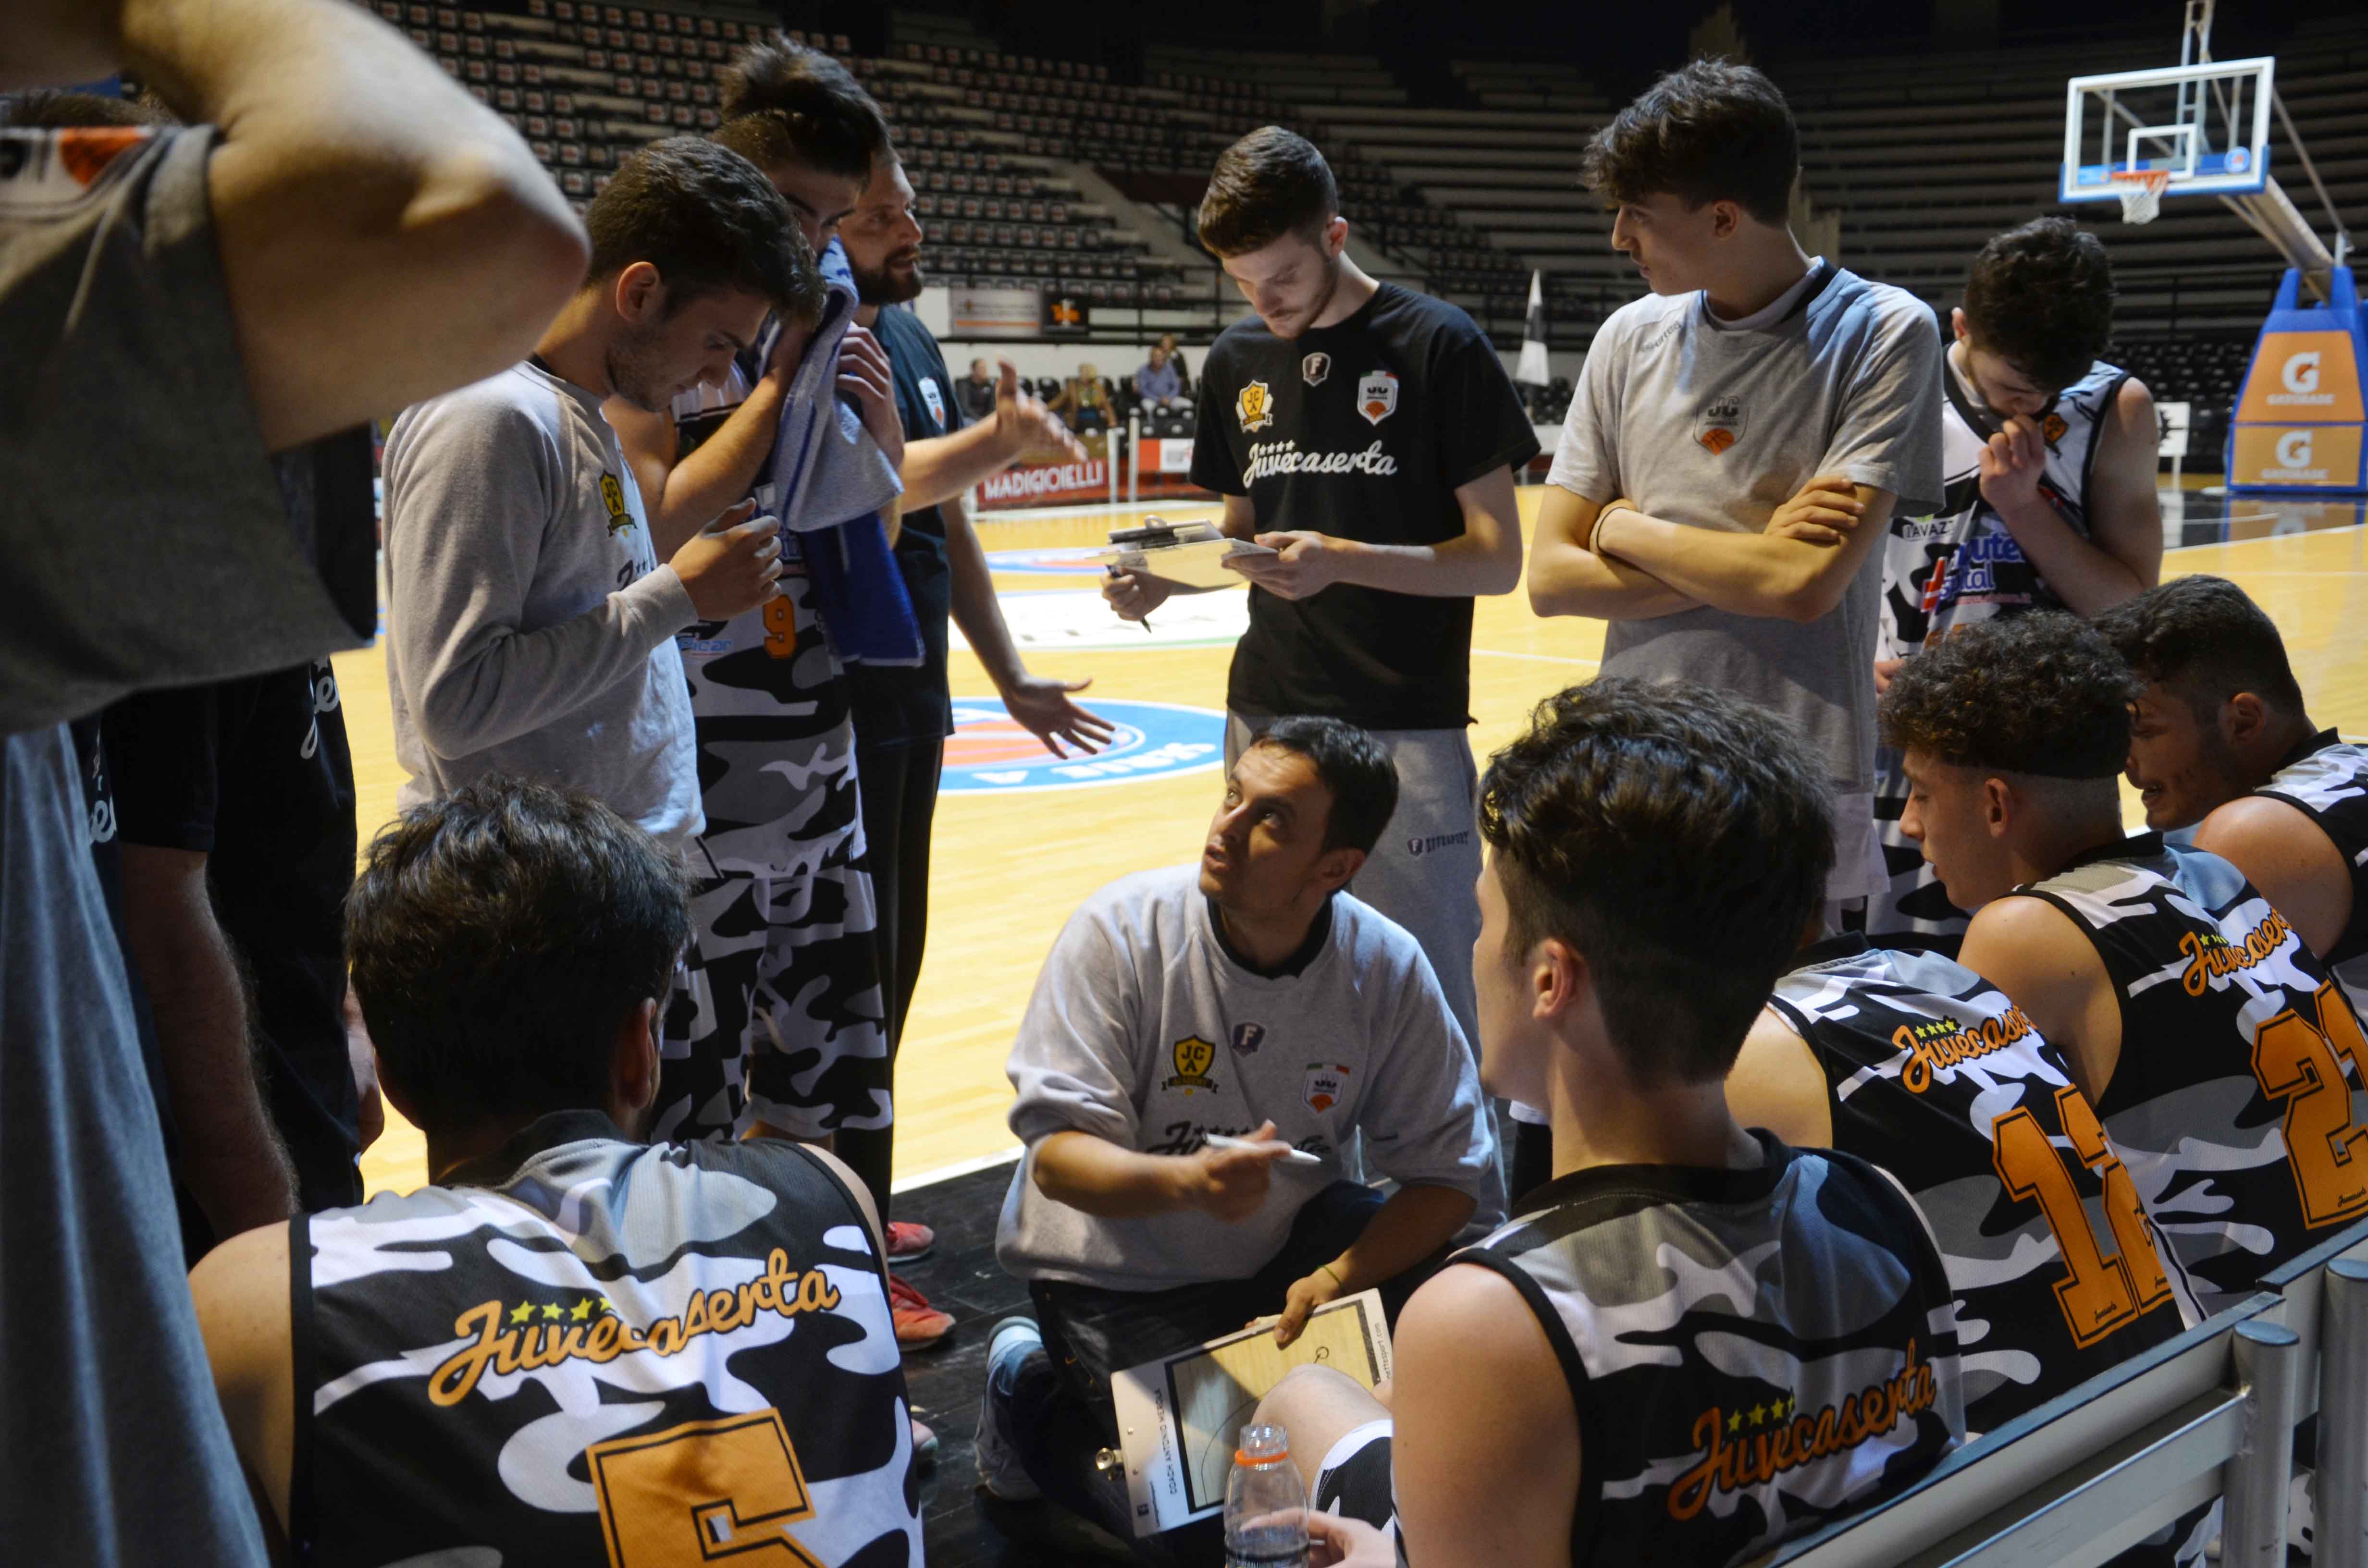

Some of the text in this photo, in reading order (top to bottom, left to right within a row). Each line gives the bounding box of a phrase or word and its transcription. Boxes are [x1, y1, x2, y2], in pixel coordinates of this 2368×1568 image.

[1309, 356, 1323, 375] F
[2281, 351, 2321, 393] G
[1243, 440, 1398, 489] Juvecaserta
[2275, 430, 2314, 468] G
[763, 595, 797, 660] 9
[1181, 1045, 1206, 1060] JC
[1240, 1025, 1258, 1047] F
[1183, 1058, 1198, 1072] A
[428, 1248, 841, 1407] Juvecaserta
[1668, 1337, 1936, 1521] Juvecaserta
